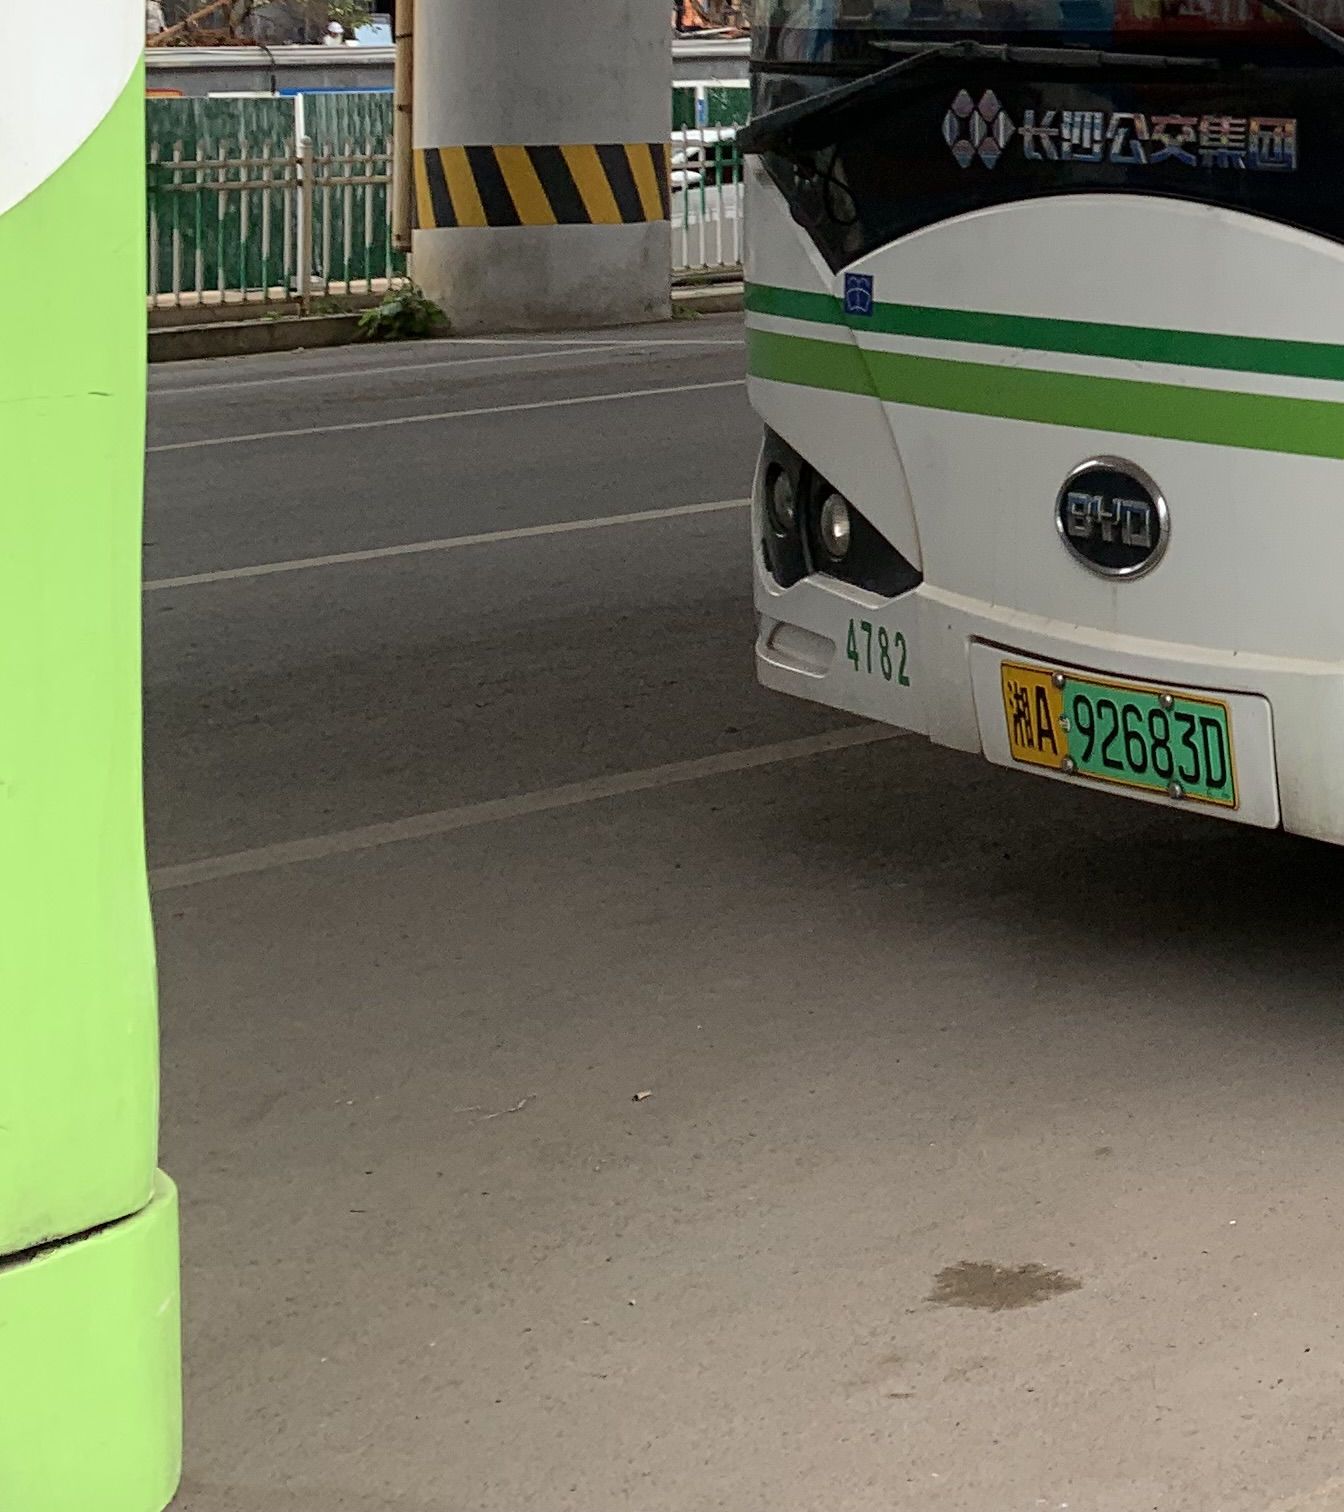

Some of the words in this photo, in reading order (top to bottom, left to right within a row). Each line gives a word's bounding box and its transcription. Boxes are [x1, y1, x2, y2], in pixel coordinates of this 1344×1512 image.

[1017, 108, 1298, 170] 长沙公交集团
[1068, 491, 1151, 550] BYD
[845, 618, 911, 687] 4782
